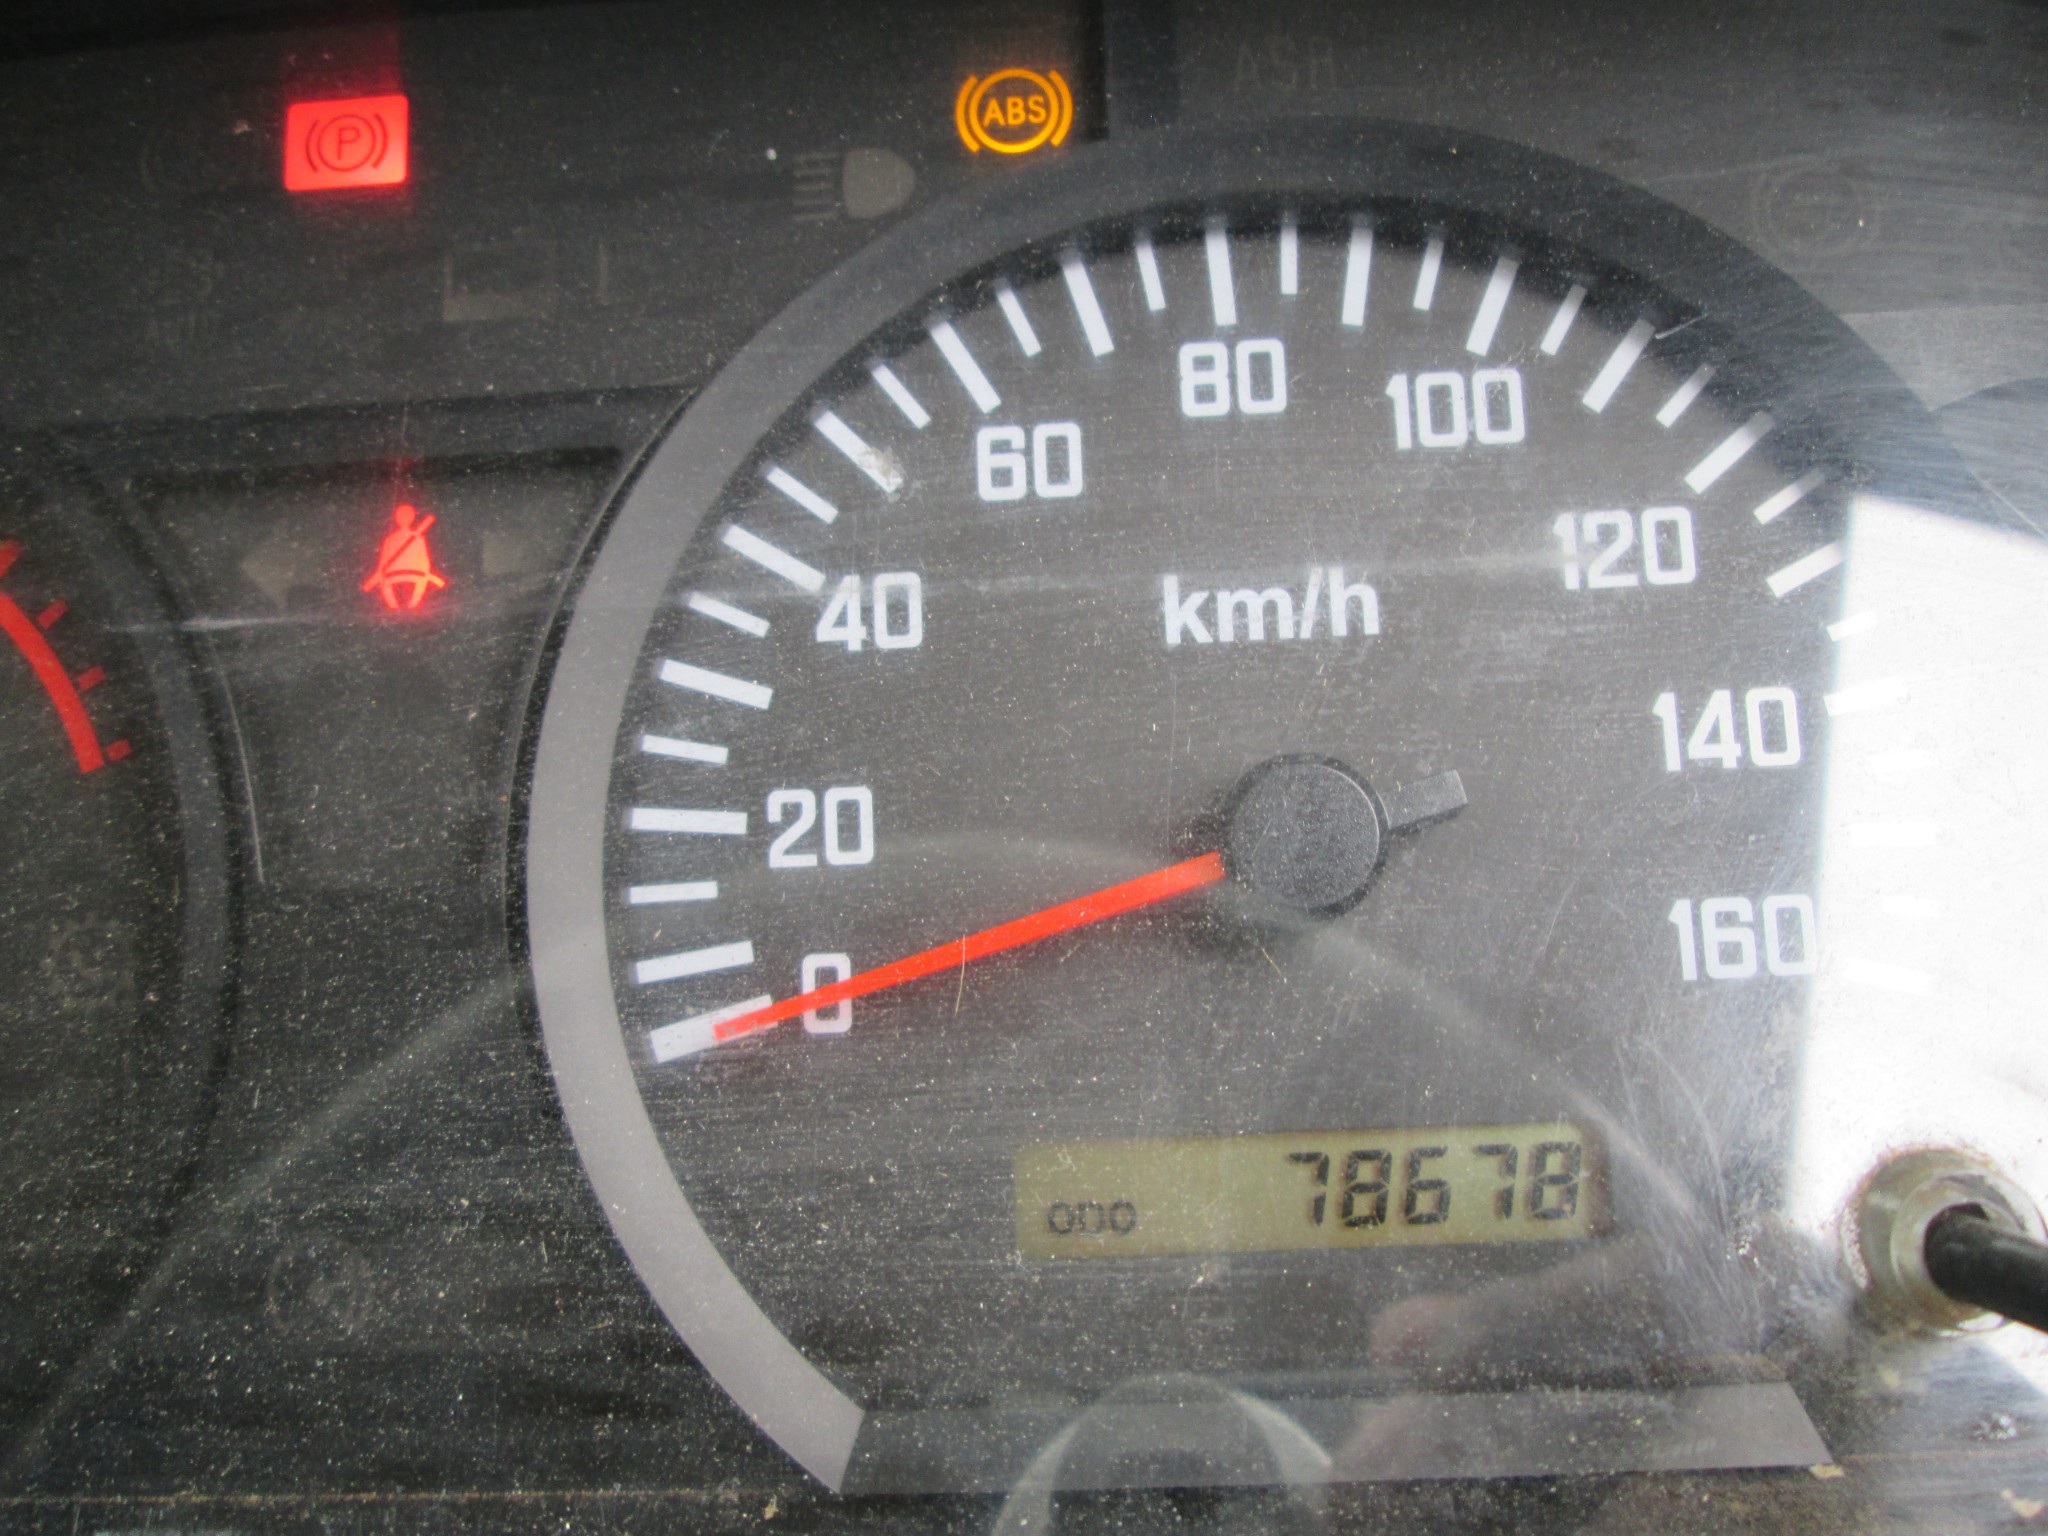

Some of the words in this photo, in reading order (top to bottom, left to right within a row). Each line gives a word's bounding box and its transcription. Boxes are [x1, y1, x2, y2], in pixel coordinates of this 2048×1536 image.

[337, 126, 361, 161] P
[983, 94, 1047, 127] ABS
[1178, 338, 1288, 418] 80
[1386, 367, 1526, 450] 100
[976, 421, 1084, 502] 60
[1552, 506, 1697, 591] 120
[814, 570, 924, 652] 40
[1161, 565, 1380, 646] km/h
[1653, 685, 1803, 772] 140
[767, 785, 875, 869] 20
[1669, 893, 1816, 983] 160
[801, 952, 853, 1034] 0
[1046, 1198, 1137, 1238] ODO
[1287, 1140, 1583, 1230] 78678
